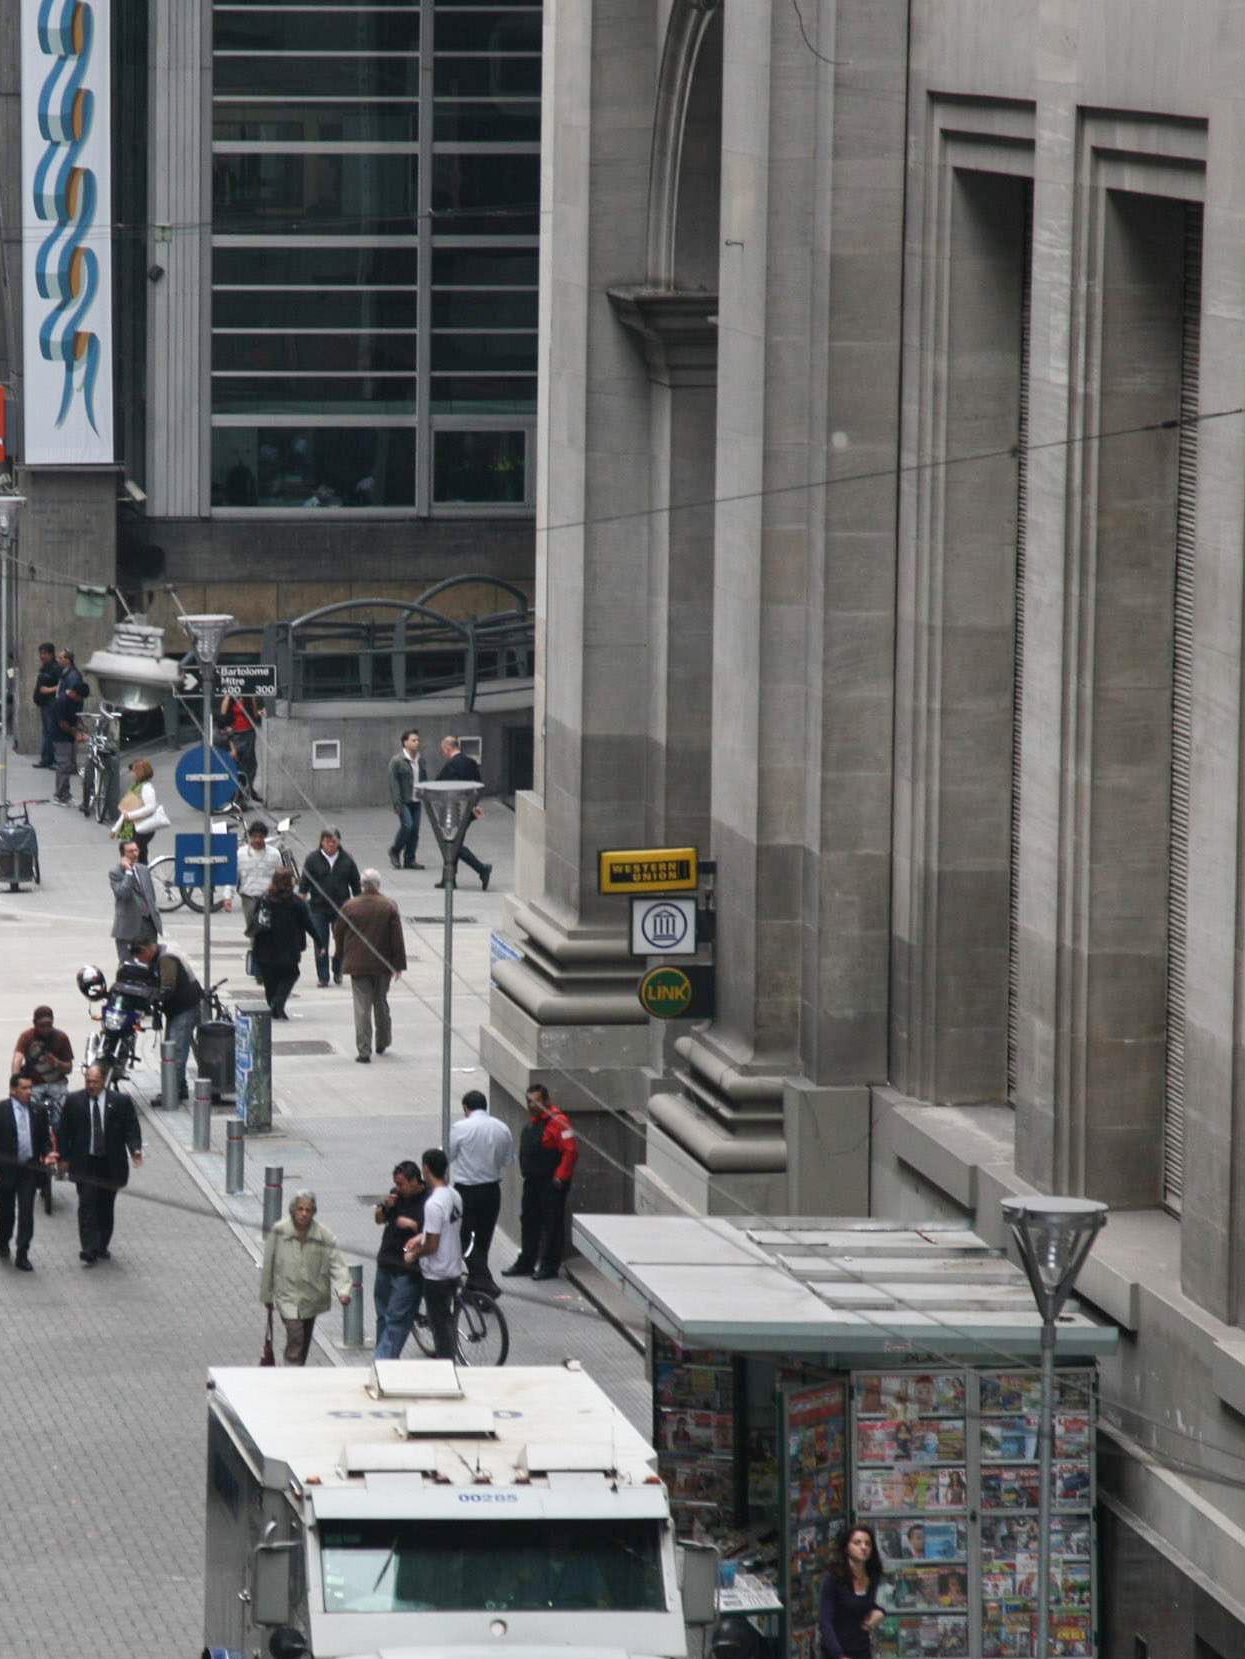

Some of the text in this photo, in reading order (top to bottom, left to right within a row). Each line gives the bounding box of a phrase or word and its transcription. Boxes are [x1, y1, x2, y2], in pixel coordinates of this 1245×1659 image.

[220, 677, 246, 687] Mitre
[256, 685, 275, 696] 300
[611, 861, 677, 874] WESTERN
[632, 871, 677, 882] UNION
